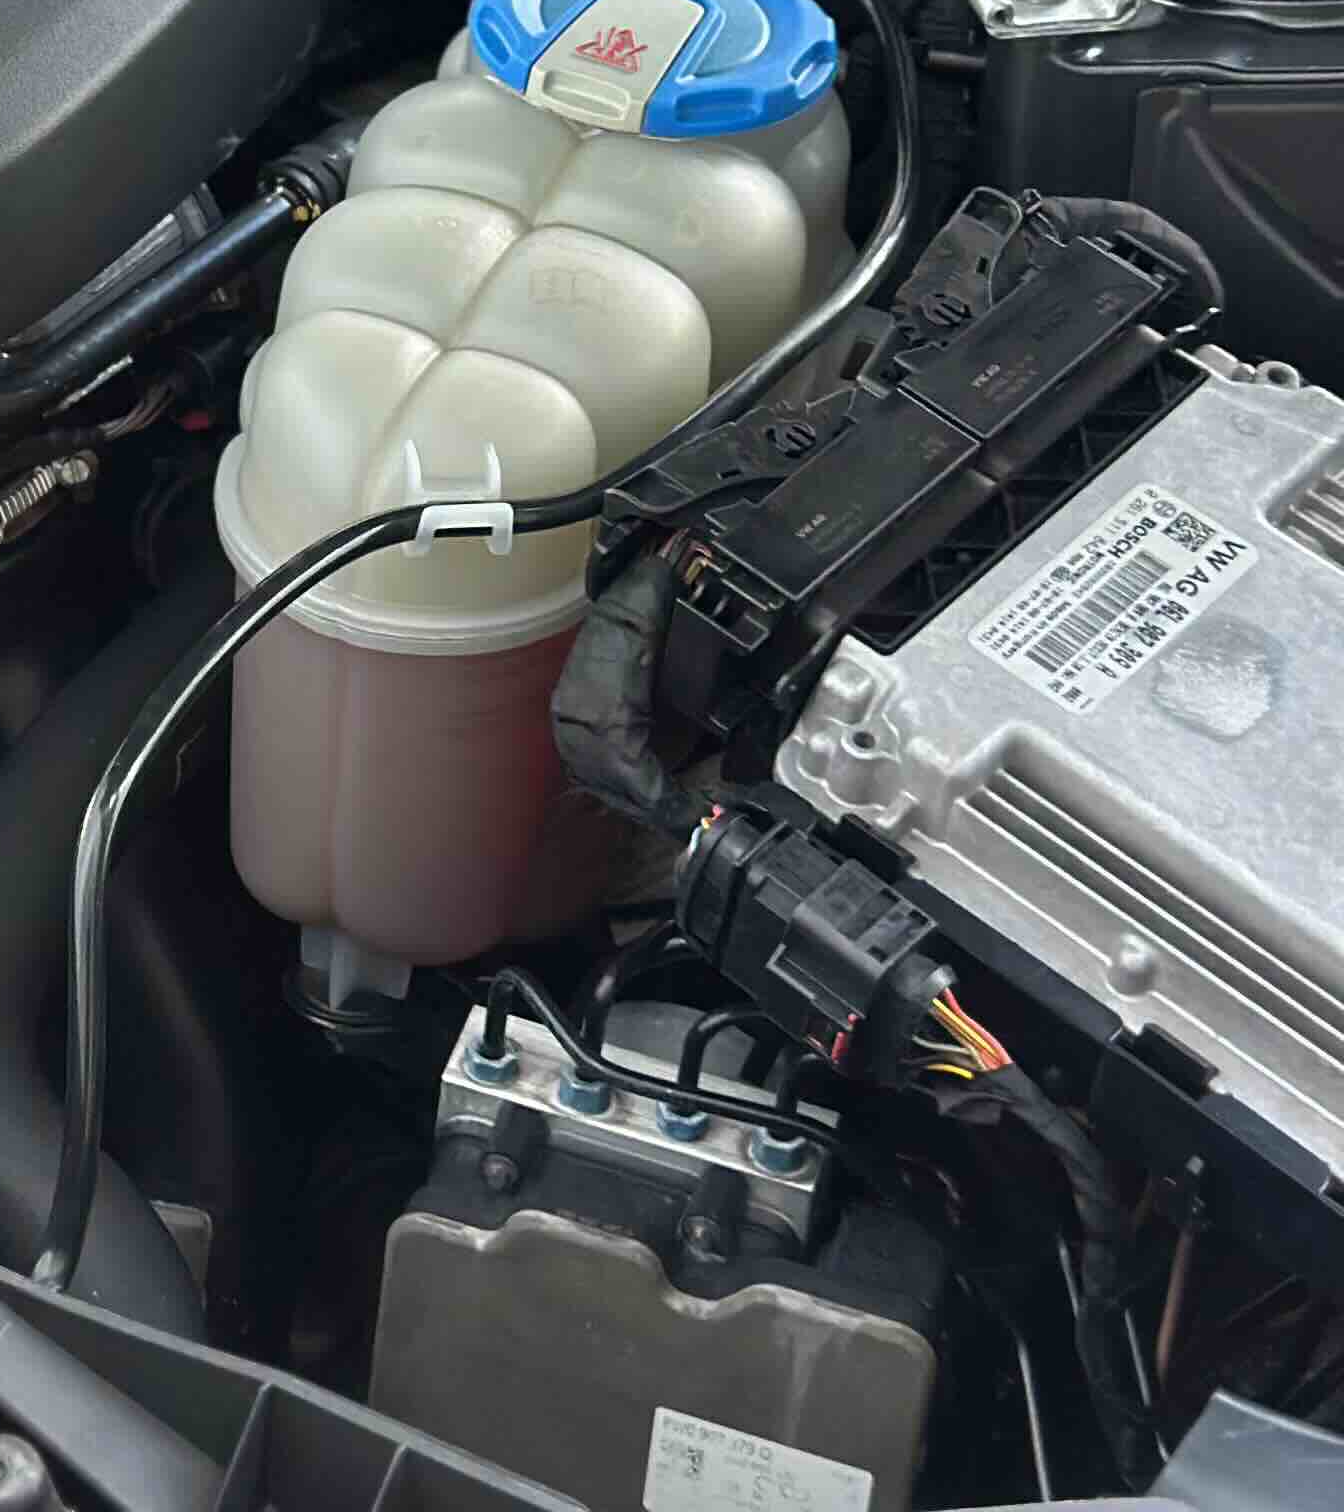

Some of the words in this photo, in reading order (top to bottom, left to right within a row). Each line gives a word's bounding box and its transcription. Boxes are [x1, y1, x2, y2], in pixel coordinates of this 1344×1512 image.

[1110, 517, 1158, 560] BOSCH
[1209, 539, 1248, 573] VW
[1175, 570, 1212, 598] AG
[1135, 620, 1168, 648] 907
